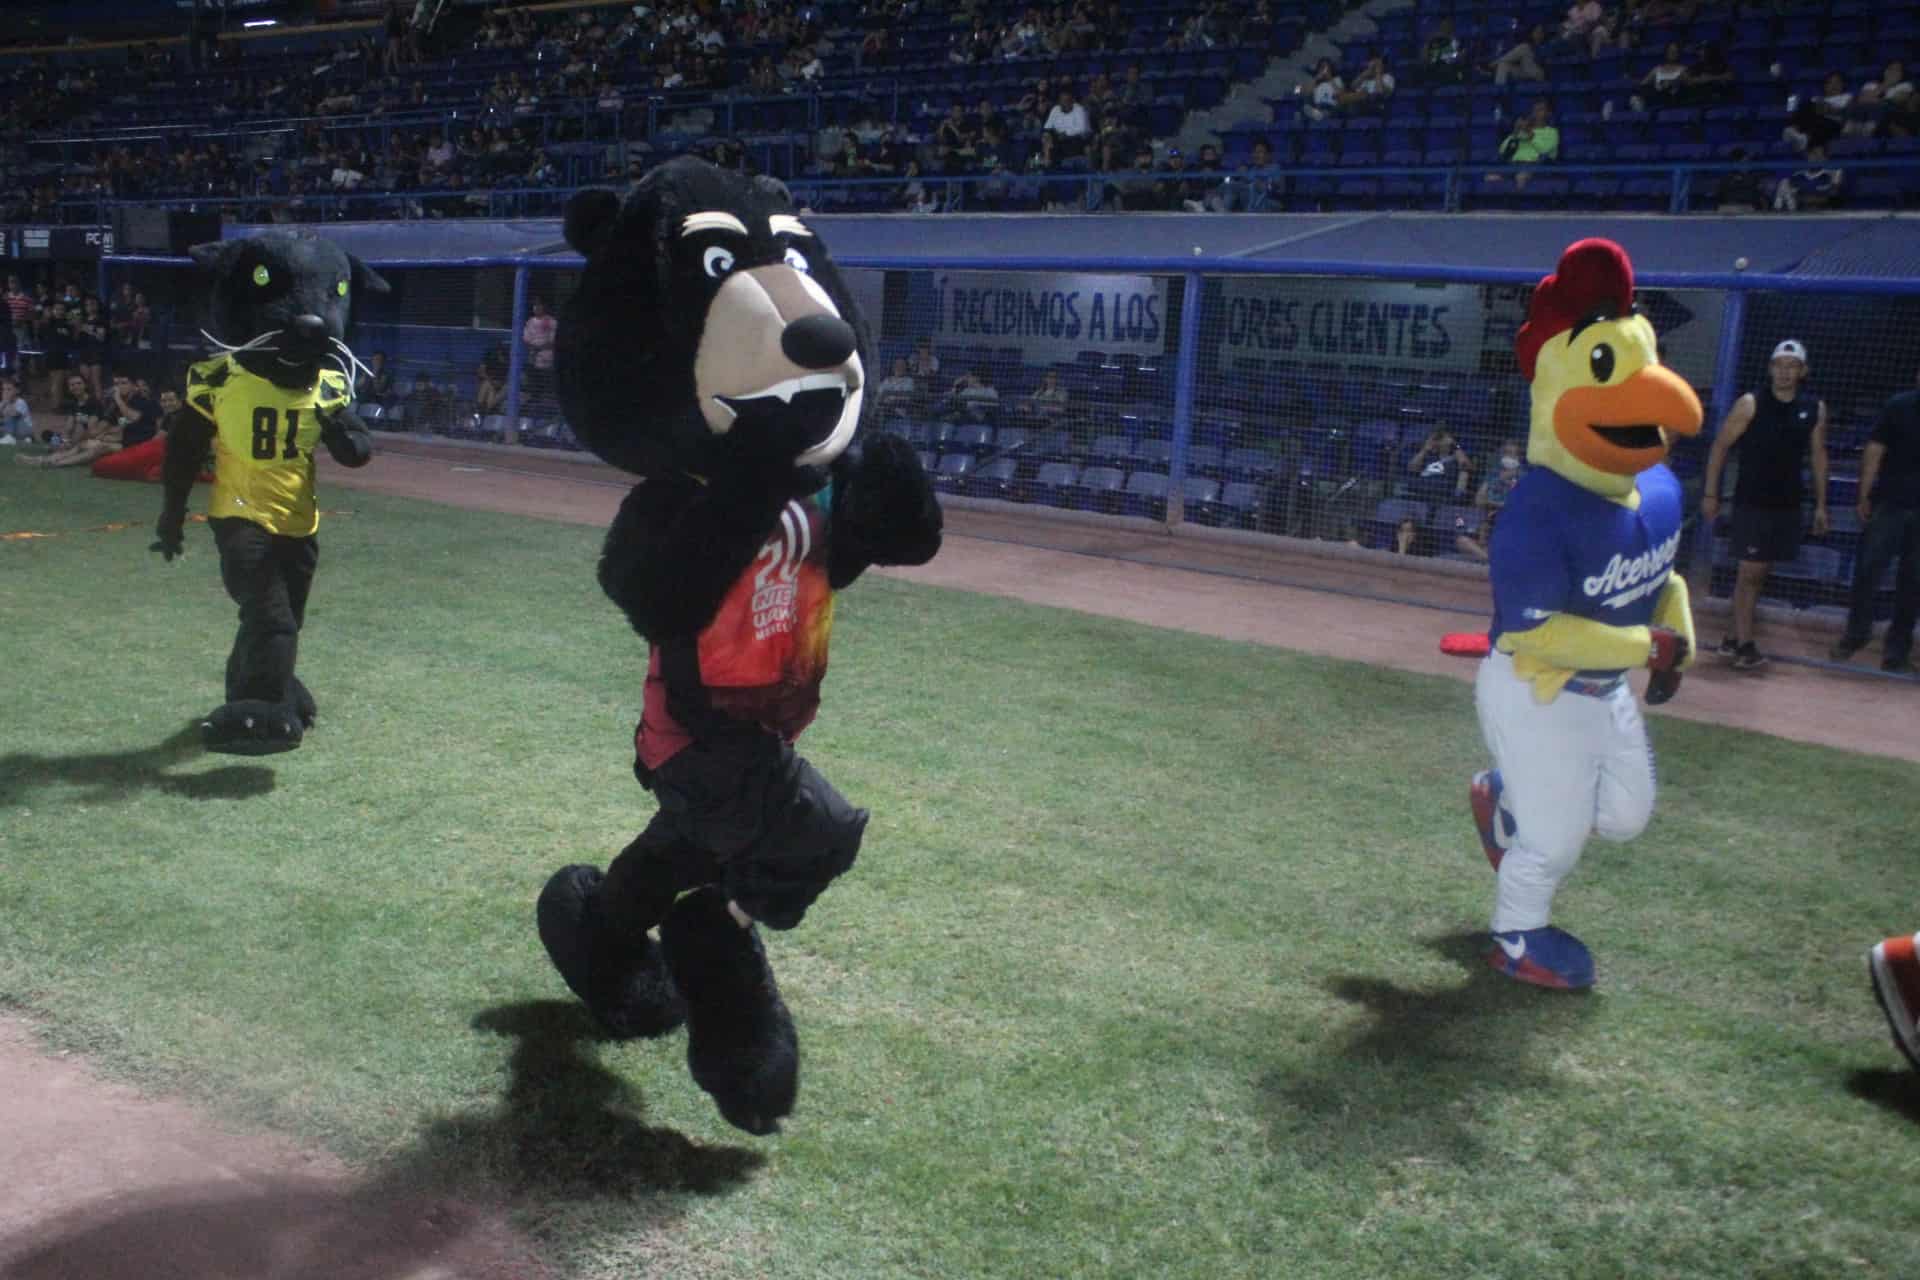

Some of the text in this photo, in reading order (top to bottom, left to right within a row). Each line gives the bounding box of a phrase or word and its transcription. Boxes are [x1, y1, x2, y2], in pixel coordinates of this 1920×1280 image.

[953, 287, 1081, 340] RECIBIMOS
[1088, 292, 1105, 342] A
[1112, 293, 1160, 344] LOS
[1309, 299, 1452, 359] CLIENTES
[251, 406, 299, 460] 81
